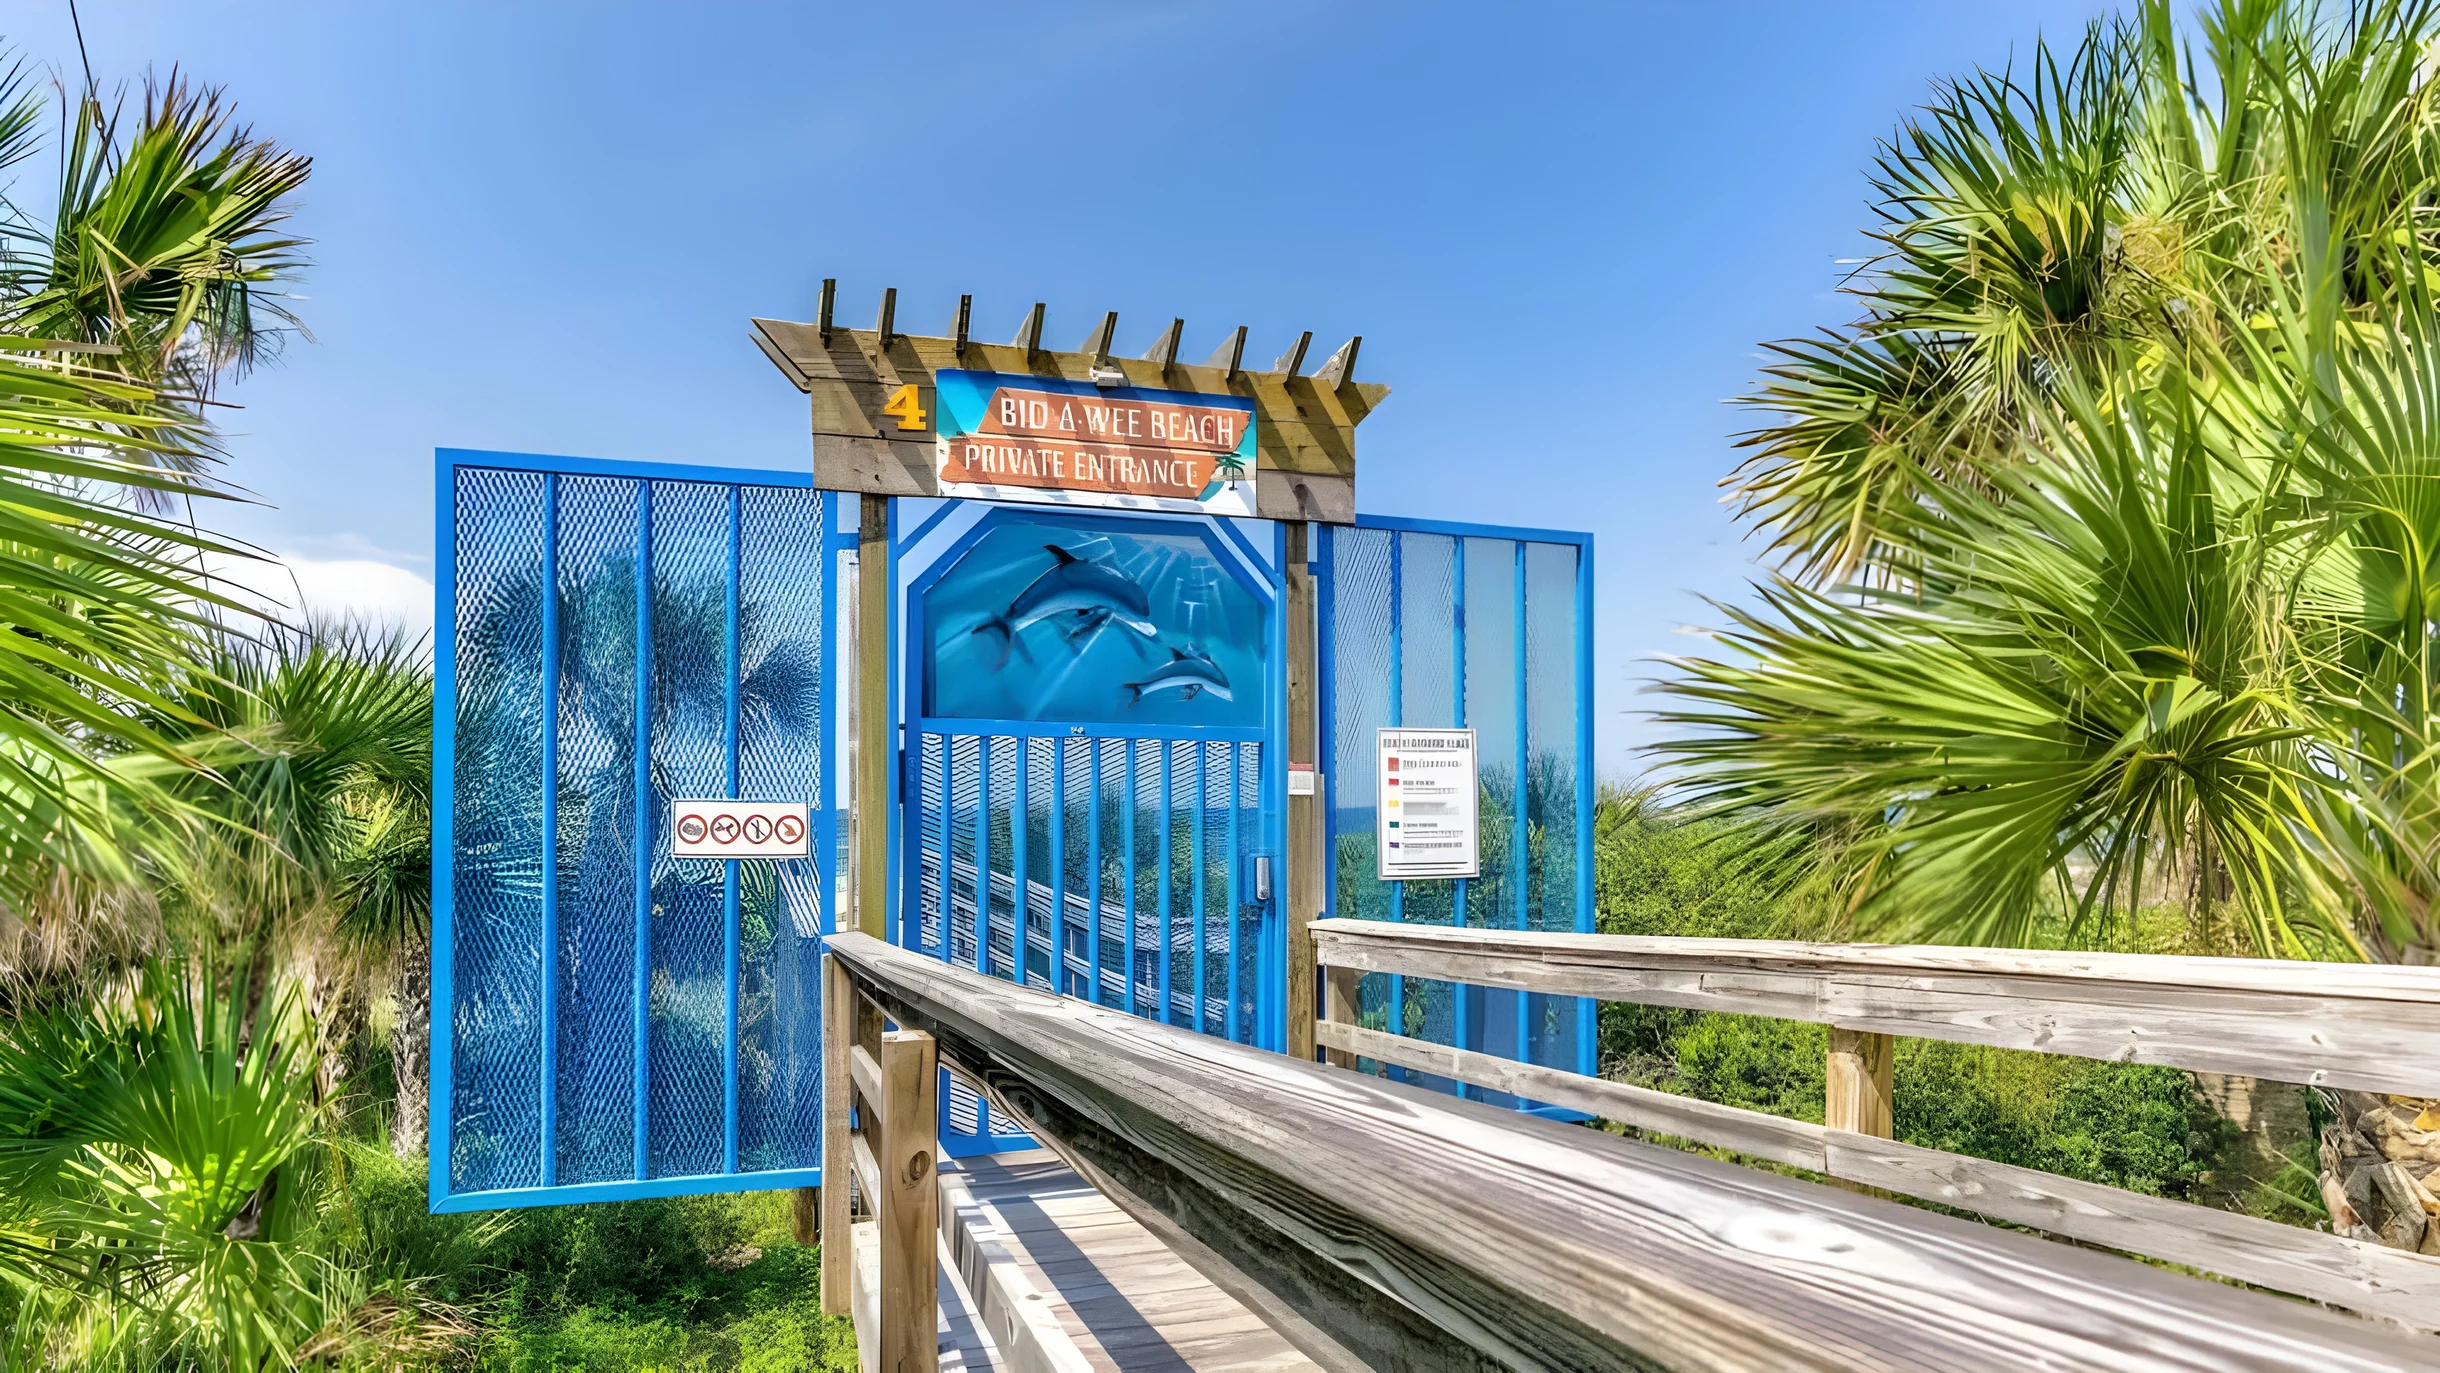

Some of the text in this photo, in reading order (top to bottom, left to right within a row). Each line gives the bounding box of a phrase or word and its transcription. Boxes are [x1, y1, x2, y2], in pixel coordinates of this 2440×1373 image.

[883, 384, 927, 430] 4
[1001, 397, 1048, 429] BID
[1151, 410, 1233, 448] BEACH
[965, 444, 1198, 488] PRIVATE ENTRANCE
